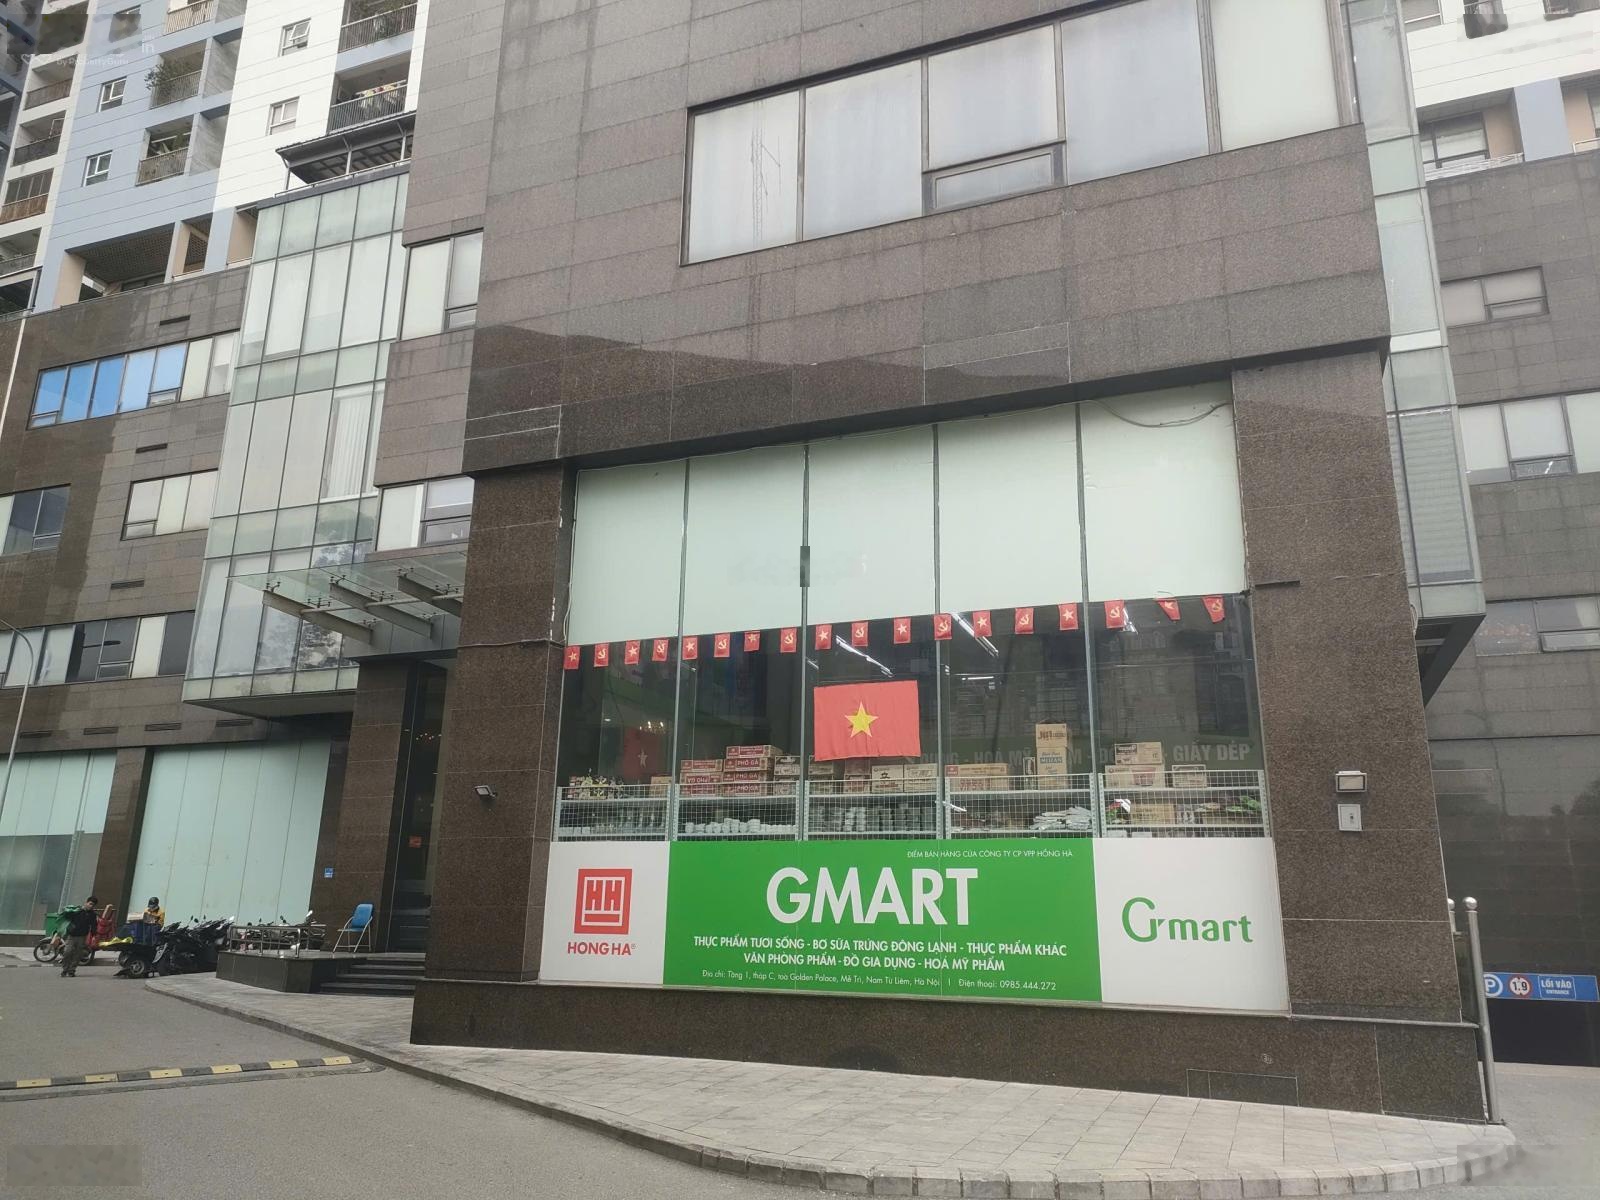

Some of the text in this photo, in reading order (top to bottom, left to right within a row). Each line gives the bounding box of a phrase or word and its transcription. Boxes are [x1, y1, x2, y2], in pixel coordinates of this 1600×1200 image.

[1216, 740, 1250, 761] DÉP
[766, 867, 979, 926] GMART
[1121, 896, 1253, 943] Gmart
[693, 935, 718, 949] THỰC
[720, 933, 748, 948] PHẨM
[750, 936, 773, 949] TƯƠI
[775, 935, 805, 950] SỐNG
[812, 938, 828, 951] BƠ
[829, 937, 851, 951] SỮA
[852, 938, 889, 952] TRỨNG
[891, 939, 925, 953] ĐÔNG
[927, 940, 957, 955] LẠNH
[966, 941, 996, 957] THỰC
[998, 940, 1032, 956] PHẨM
[1034, 942, 1068, 957] KHÁC
[743, 952, 766, 964] VĂN
[767, 951, 805, 966] PHÒNG
[806, 951, 837, 966] PHẨM
[842, 953, 860, 967] ĐỒ
[861, 956, 882, 968] GIA
[883, 956, 916, 971] DỤNG
[924, 955, 950, 970] HOÁ
[951, 957, 969, 971] MỸ
[971, 956, 1006, 972] PHẨM
[789, 972, 814, 982] Golden
[815, 973, 840, 984] Palace,
[866, 975, 884, 984] Nam
[958, 978, 976, 988] Điện
[999, 980, 1057, 991] 0985.444.272
